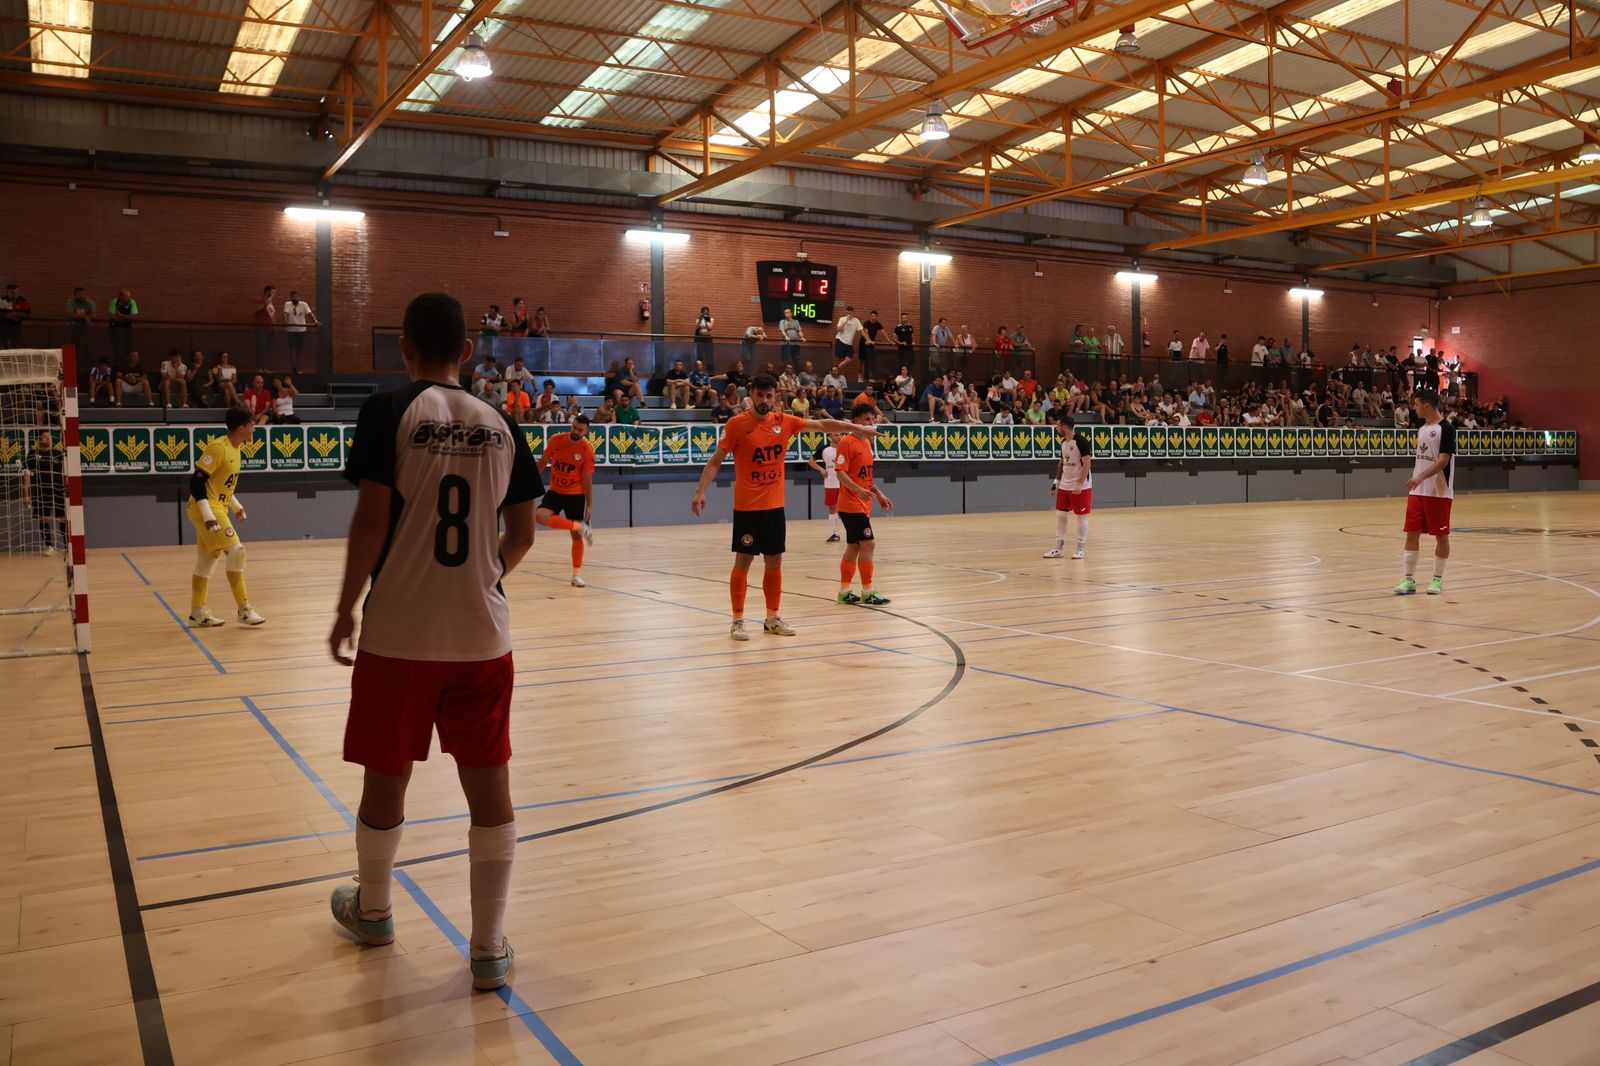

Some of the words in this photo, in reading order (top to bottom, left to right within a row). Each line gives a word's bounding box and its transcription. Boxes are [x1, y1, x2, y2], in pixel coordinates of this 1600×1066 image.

[784, 278, 788, 291] 1
[798, 280, 802, 290] 1
[820, 280, 828, 294] 2
[794, 304, 816, 318] 1:46
[752, 444, 782, 463] ATP
[554, 460, 576, 473] ATP
[434, 474, 470, 567] 8
